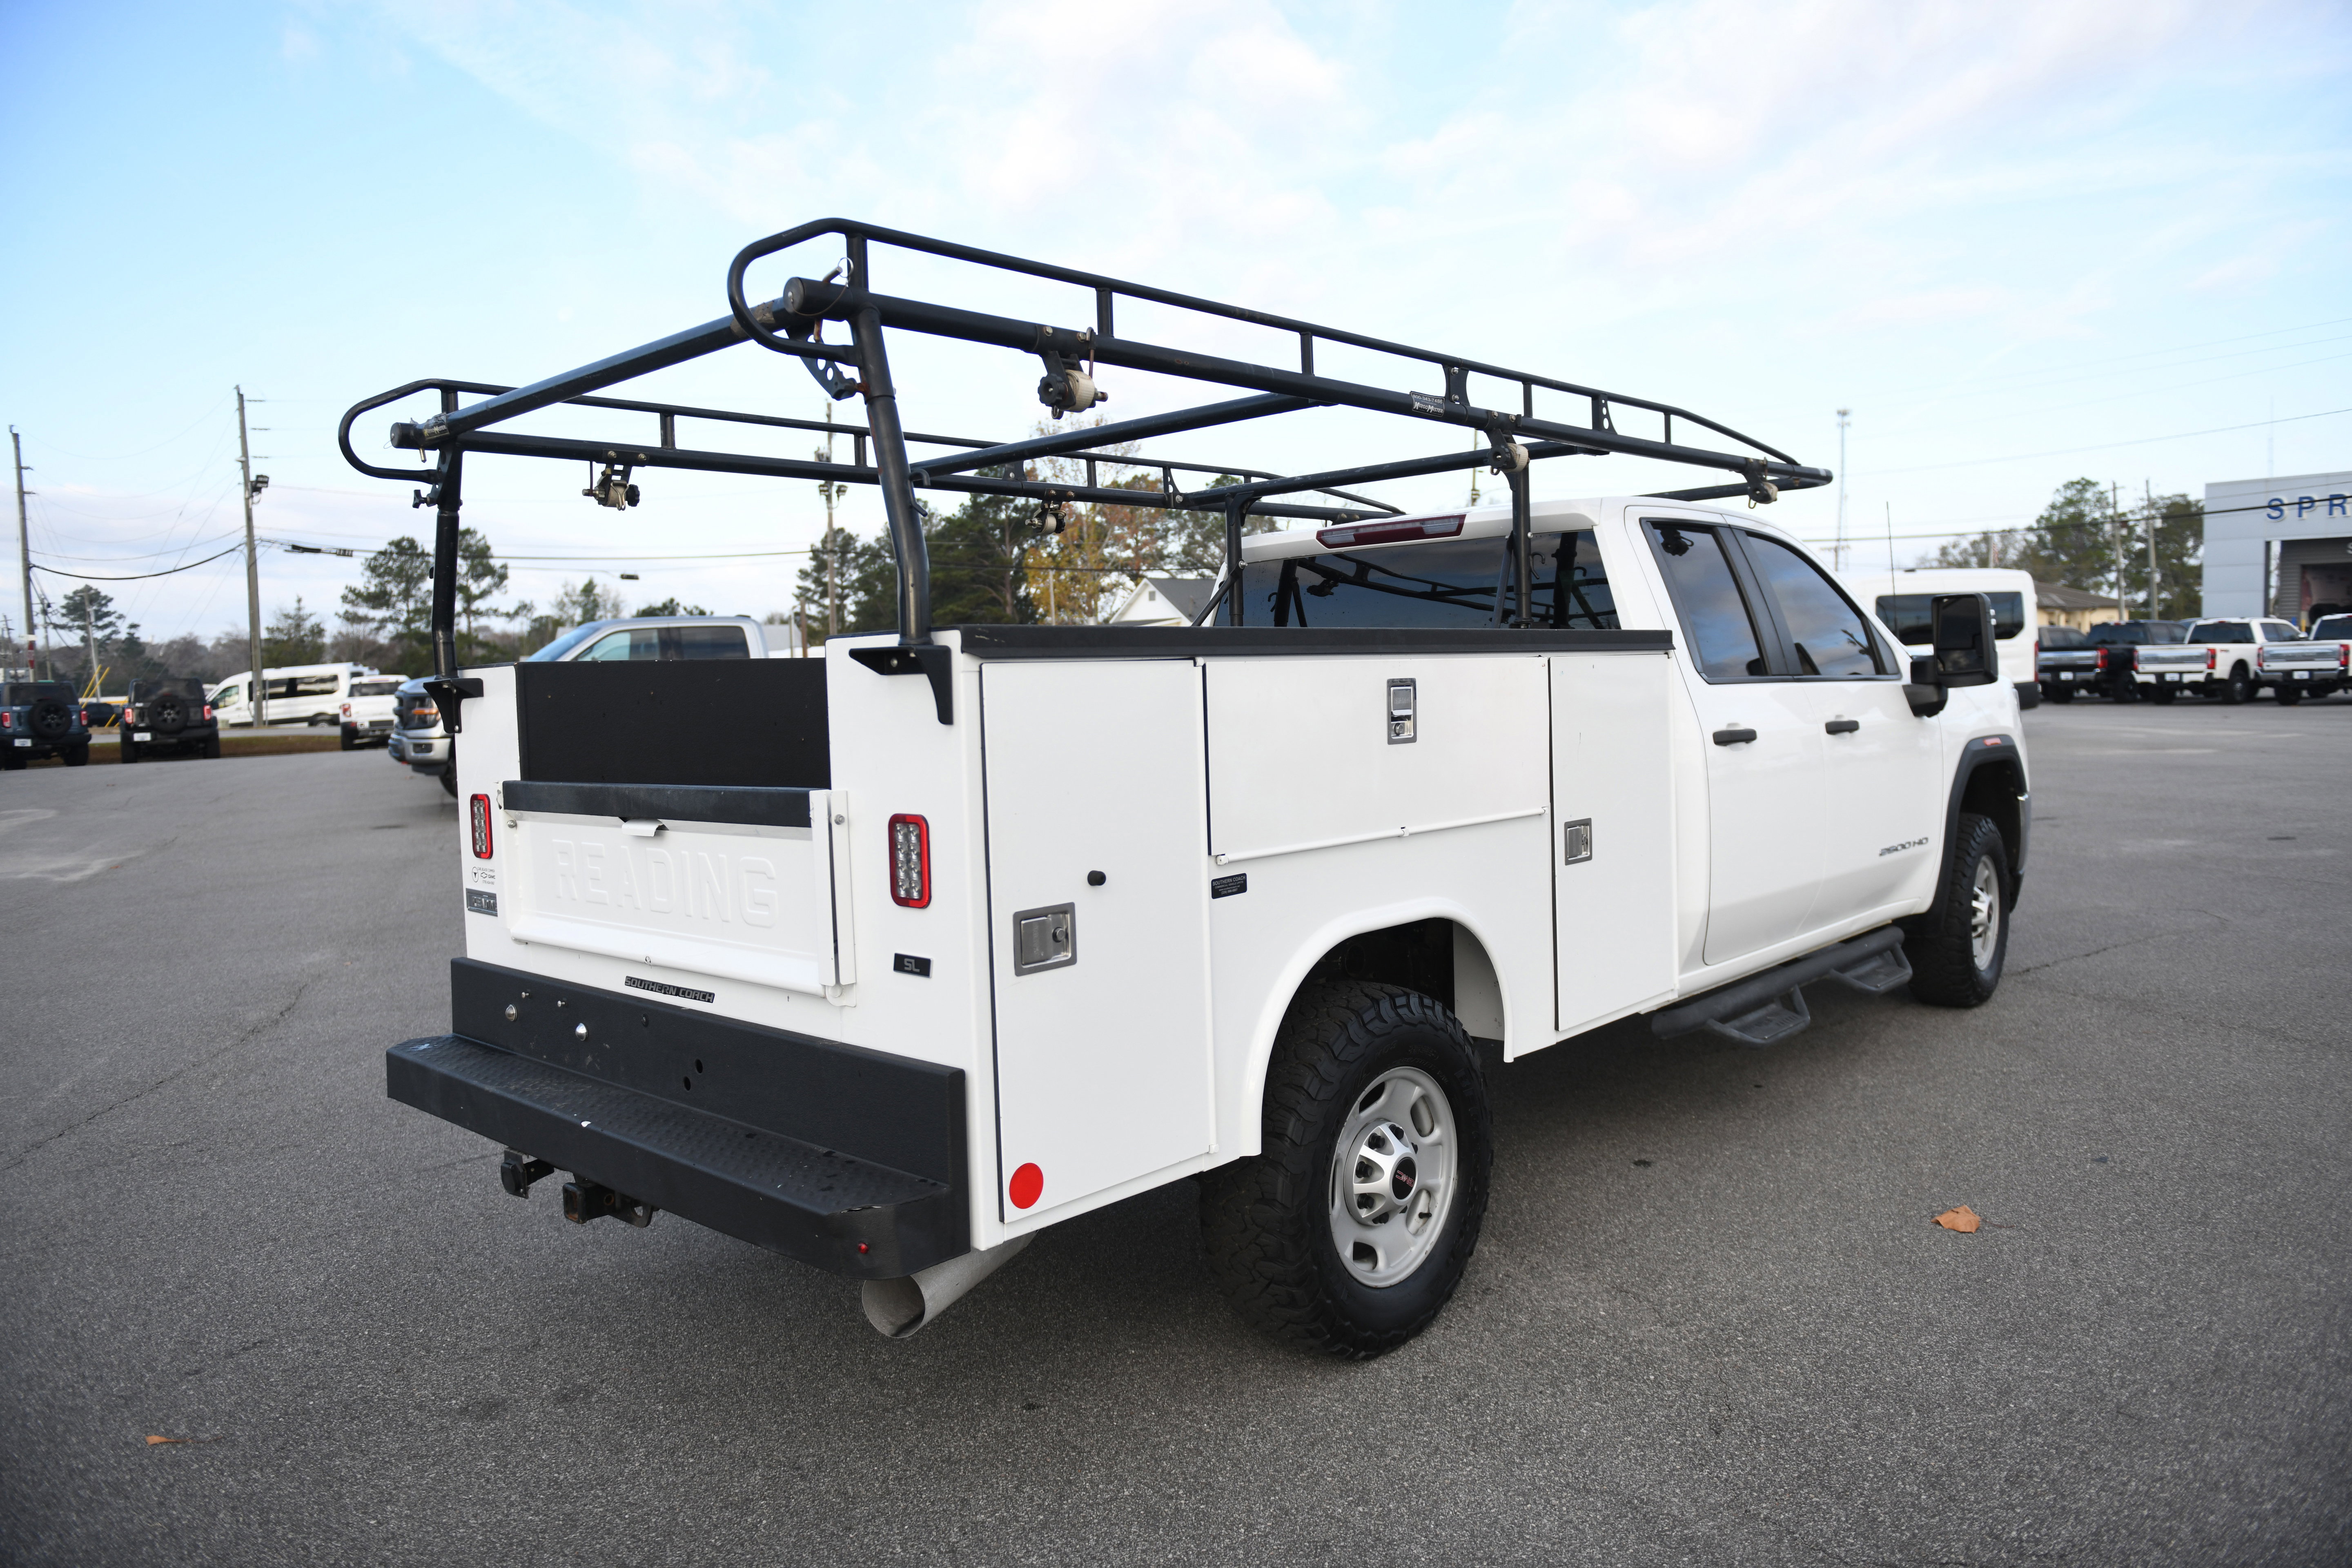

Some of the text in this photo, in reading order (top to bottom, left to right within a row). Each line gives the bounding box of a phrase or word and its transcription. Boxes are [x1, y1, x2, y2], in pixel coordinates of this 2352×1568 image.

[1413, 394, 1443, 404] 800-343-7486
[552, 840, 778, 929] READING
[904, 958, 920, 972] SL
[625, 978, 715, 1002] SOUTHERN COACH
[1396, 1170, 1414, 1187] GMC
